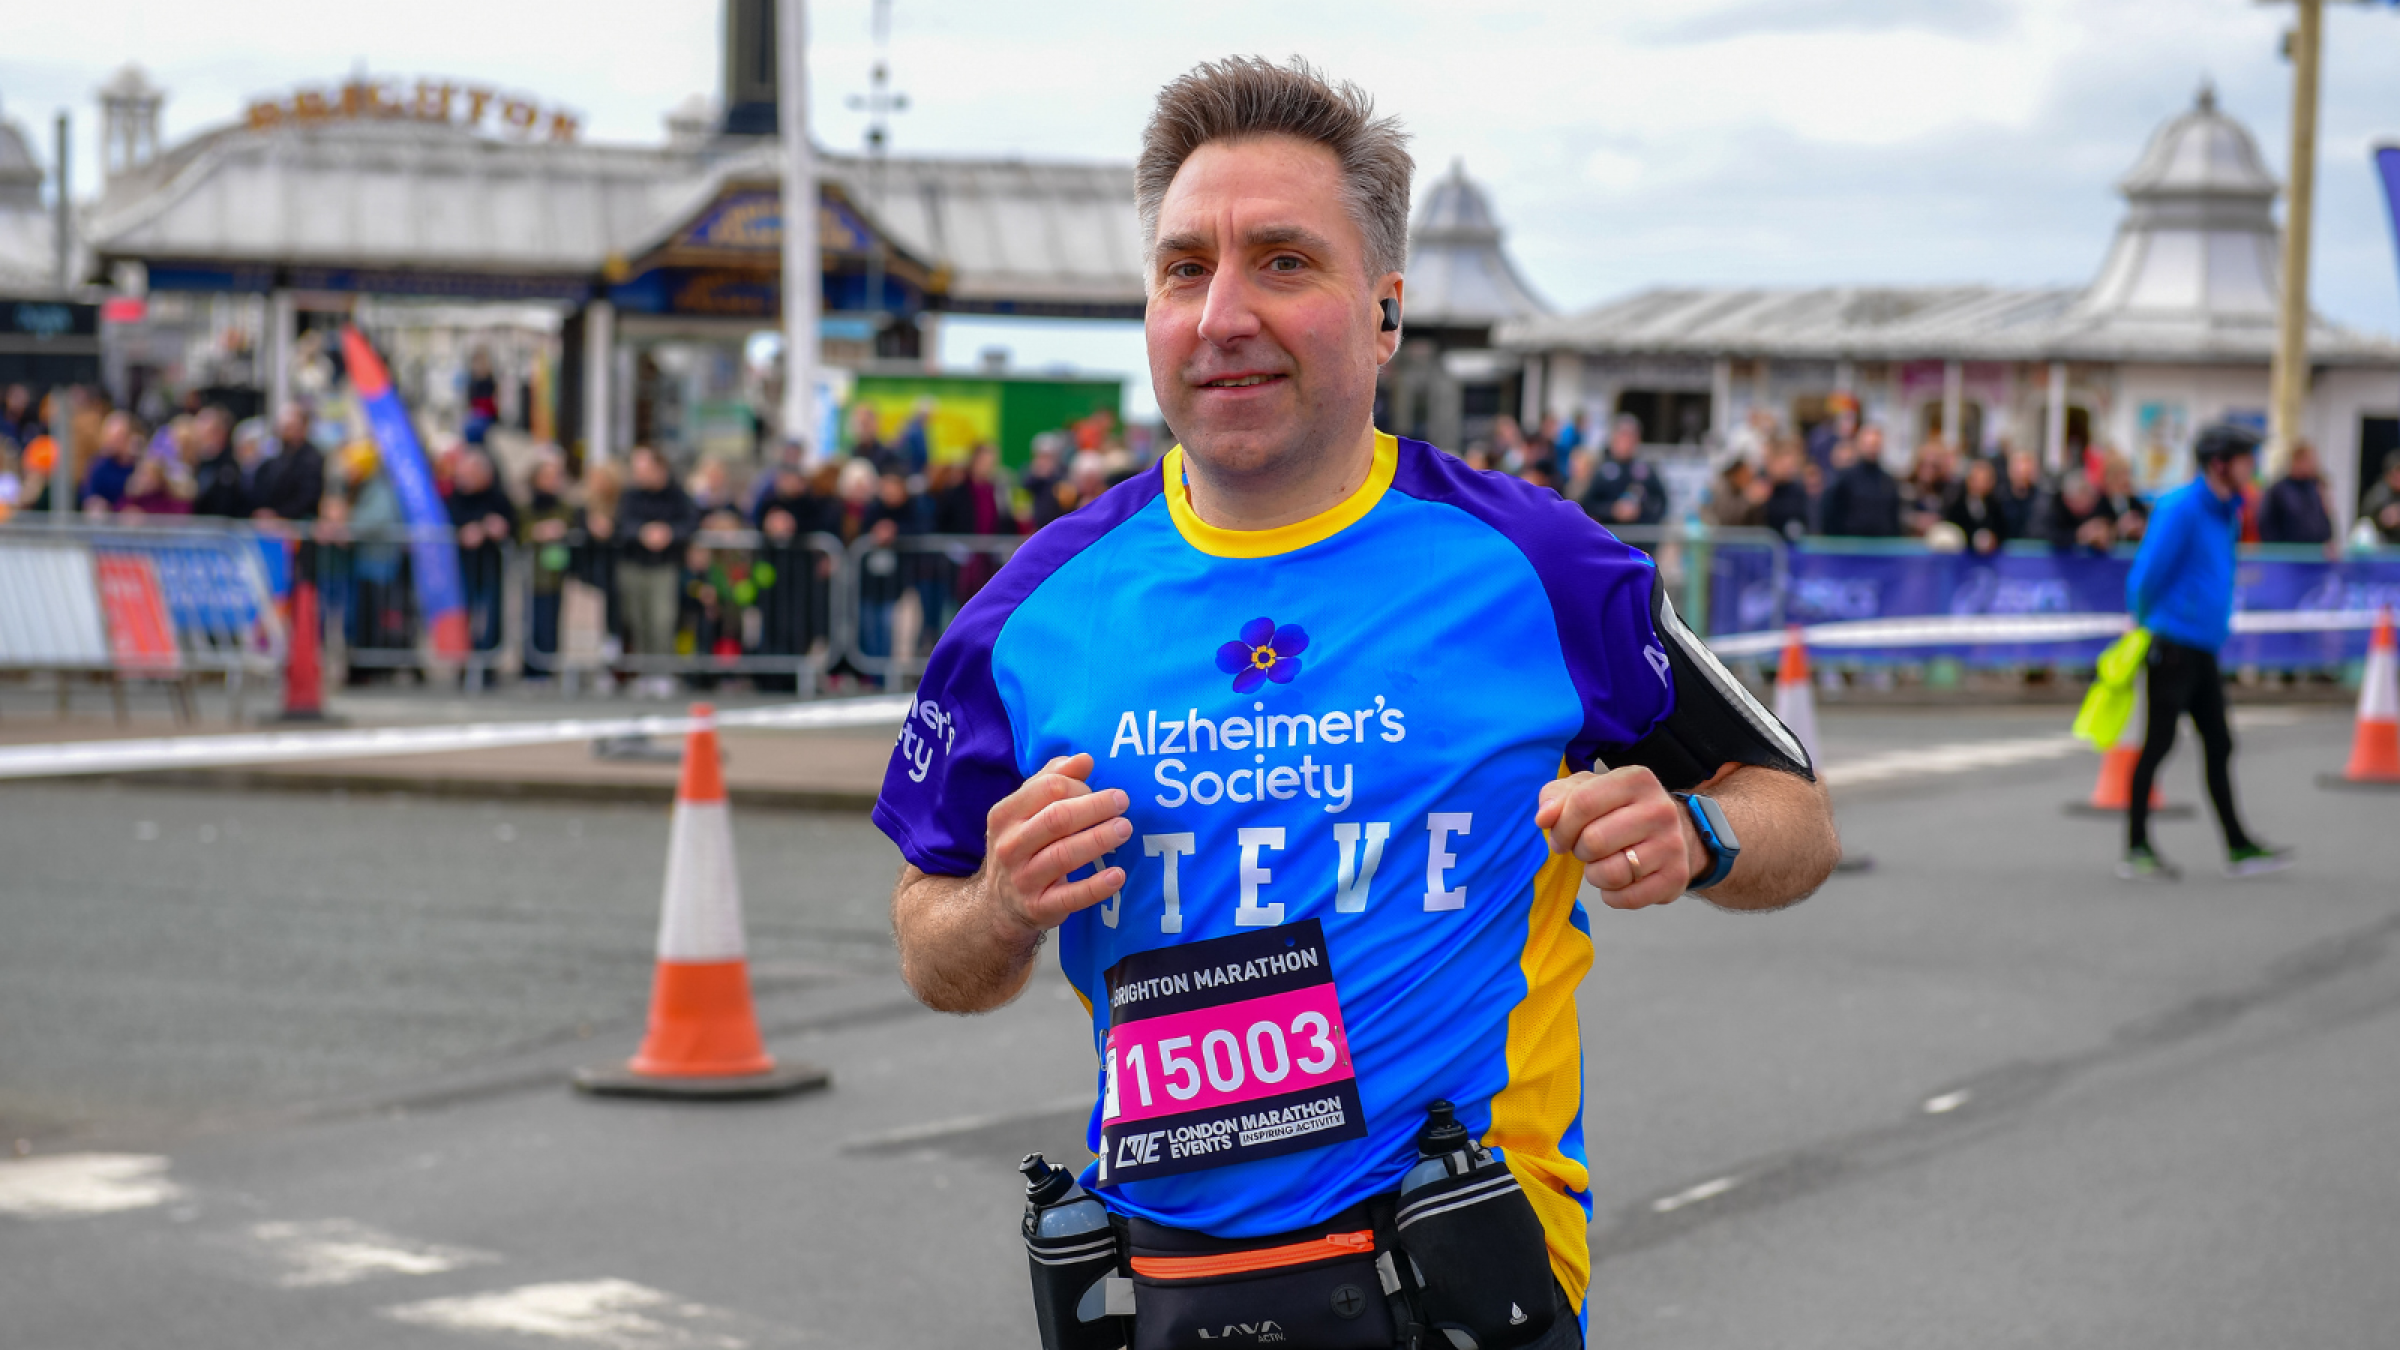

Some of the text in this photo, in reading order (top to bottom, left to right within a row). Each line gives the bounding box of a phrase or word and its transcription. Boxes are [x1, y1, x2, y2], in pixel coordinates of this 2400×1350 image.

[248, 80, 581, 135] BRIGHTON
[1109, 695, 1406, 758] Alzheimer's
[1154, 754, 1353, 813] Society
[1113, 947, 1319, 1008] BRIGHTON MARATHON
[1126, 1011, 1337, 1106] 15003
[1167, 1096, 1342, 1143] LONDON MARATHON
[1170, 1135, 1233, 1159] EVENTS
[1242, 1113, 1342, 1142] INSPIRING ACTIVITY
[1197, 1320, 1282, 1339] LAVA
